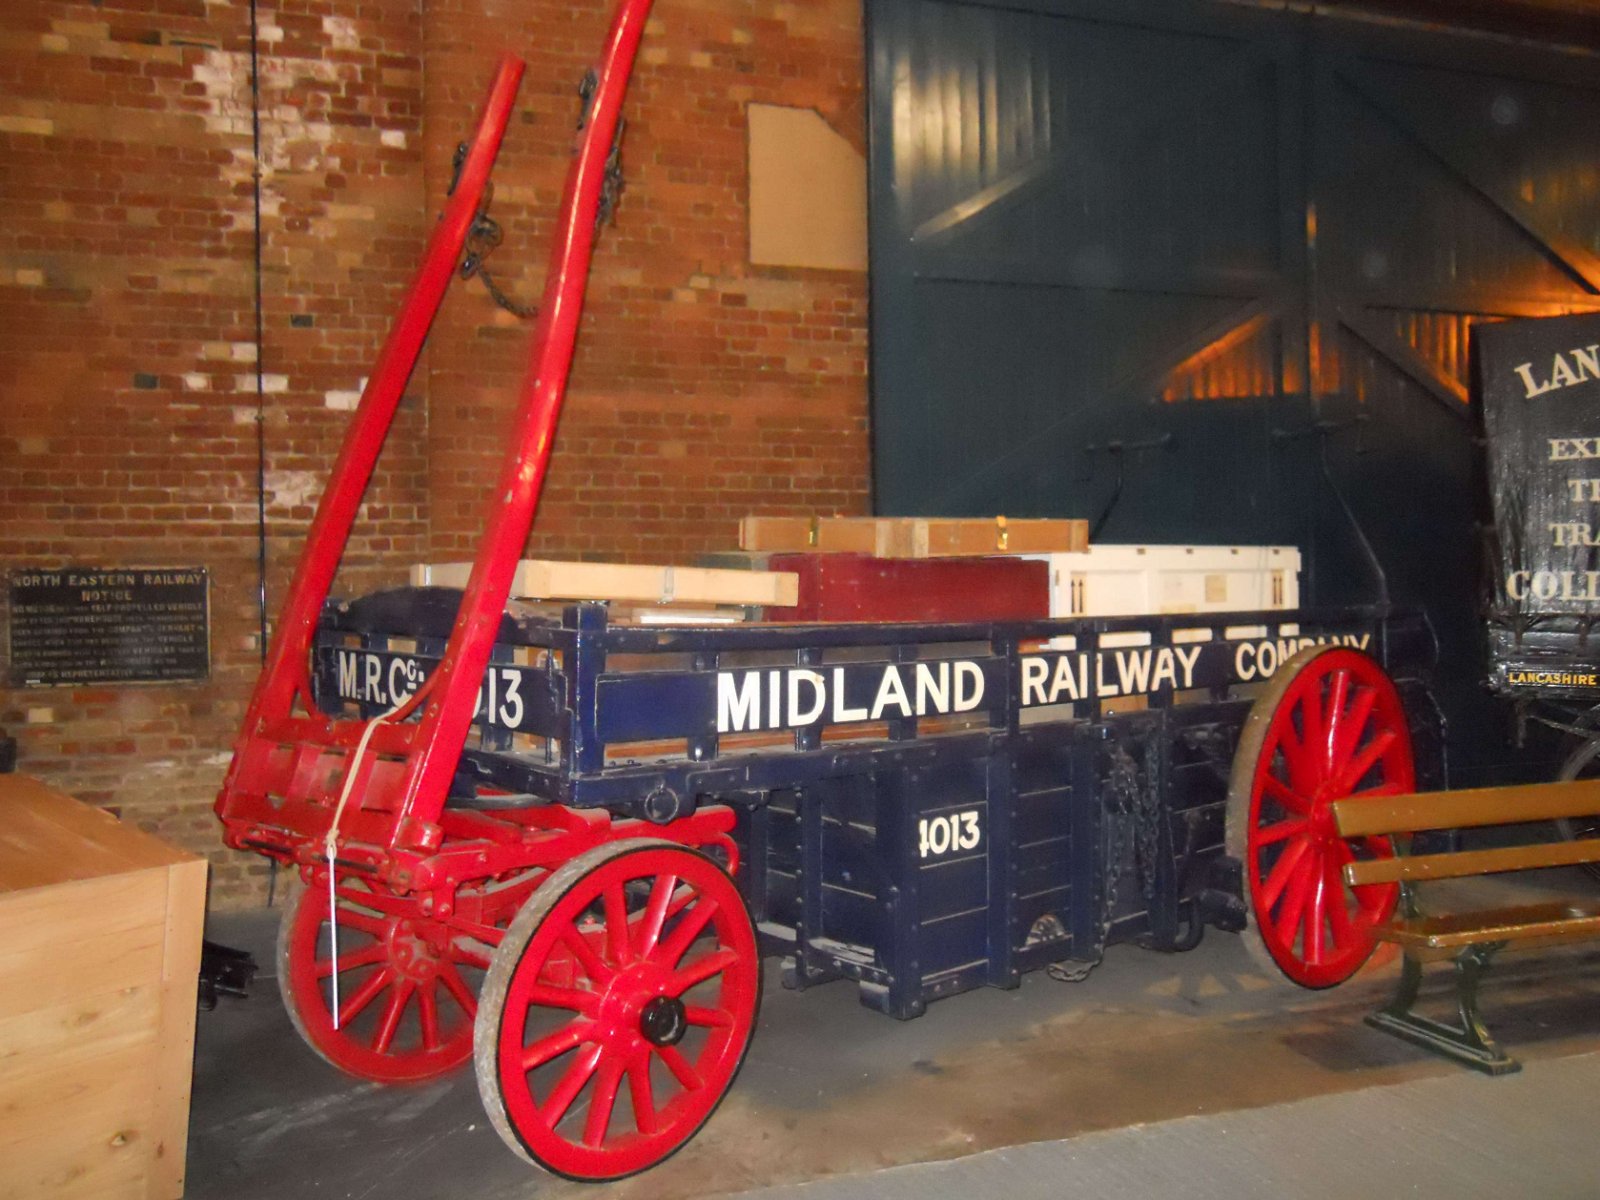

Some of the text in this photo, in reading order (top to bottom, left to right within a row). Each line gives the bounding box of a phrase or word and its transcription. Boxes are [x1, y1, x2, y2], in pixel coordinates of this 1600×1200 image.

[1548, 522, 1600, 546] TR
[13, 574, 201, 587] NORTH EASTERN RAILWAY
[81, 590, 133, 602] NOTICE
[1508, 672, 1597, 686] LANCASHIRE
[717, 660, 985, 733] MIDLAND
[1021, 646, 1202, 705] RAILWAY
[919, 810, 981, 858] 1013
